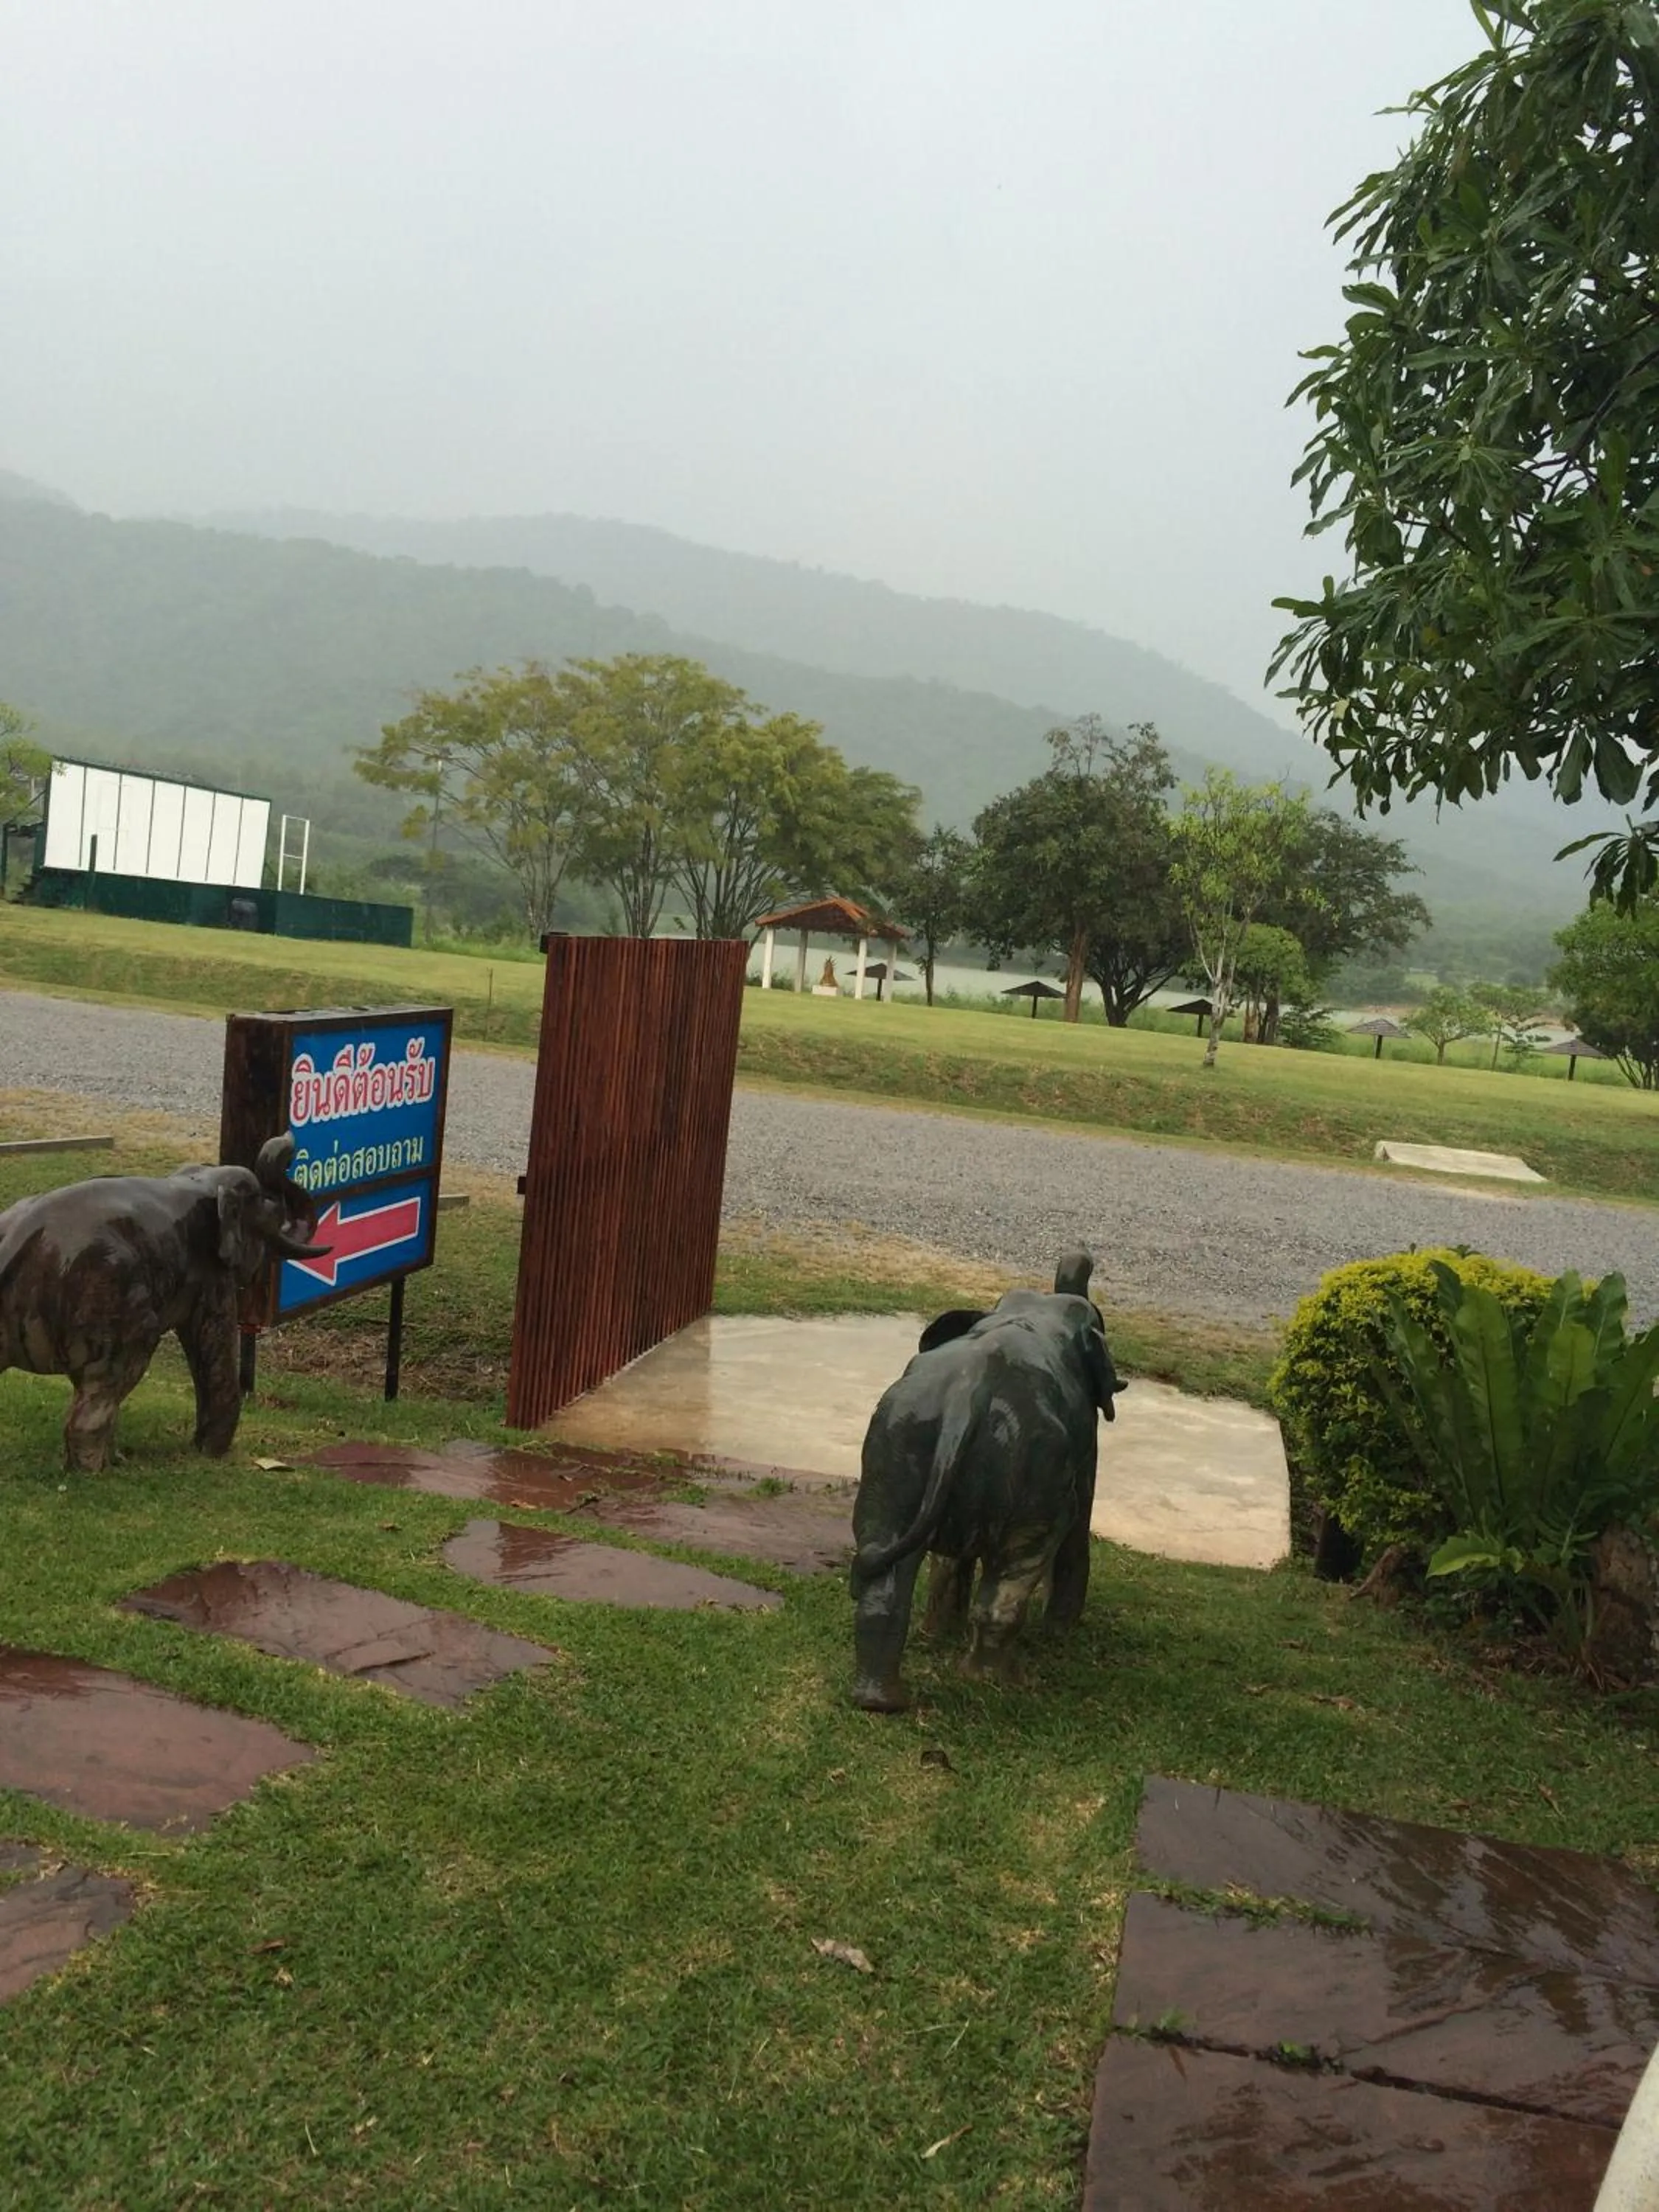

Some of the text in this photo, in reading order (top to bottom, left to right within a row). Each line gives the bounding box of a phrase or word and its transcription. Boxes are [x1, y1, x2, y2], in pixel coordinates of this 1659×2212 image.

[291, 1037, 435, 1127] ยินดีต้อนรับ
[295, 1135, 424, 1191] ติดต่อสอบถาม
